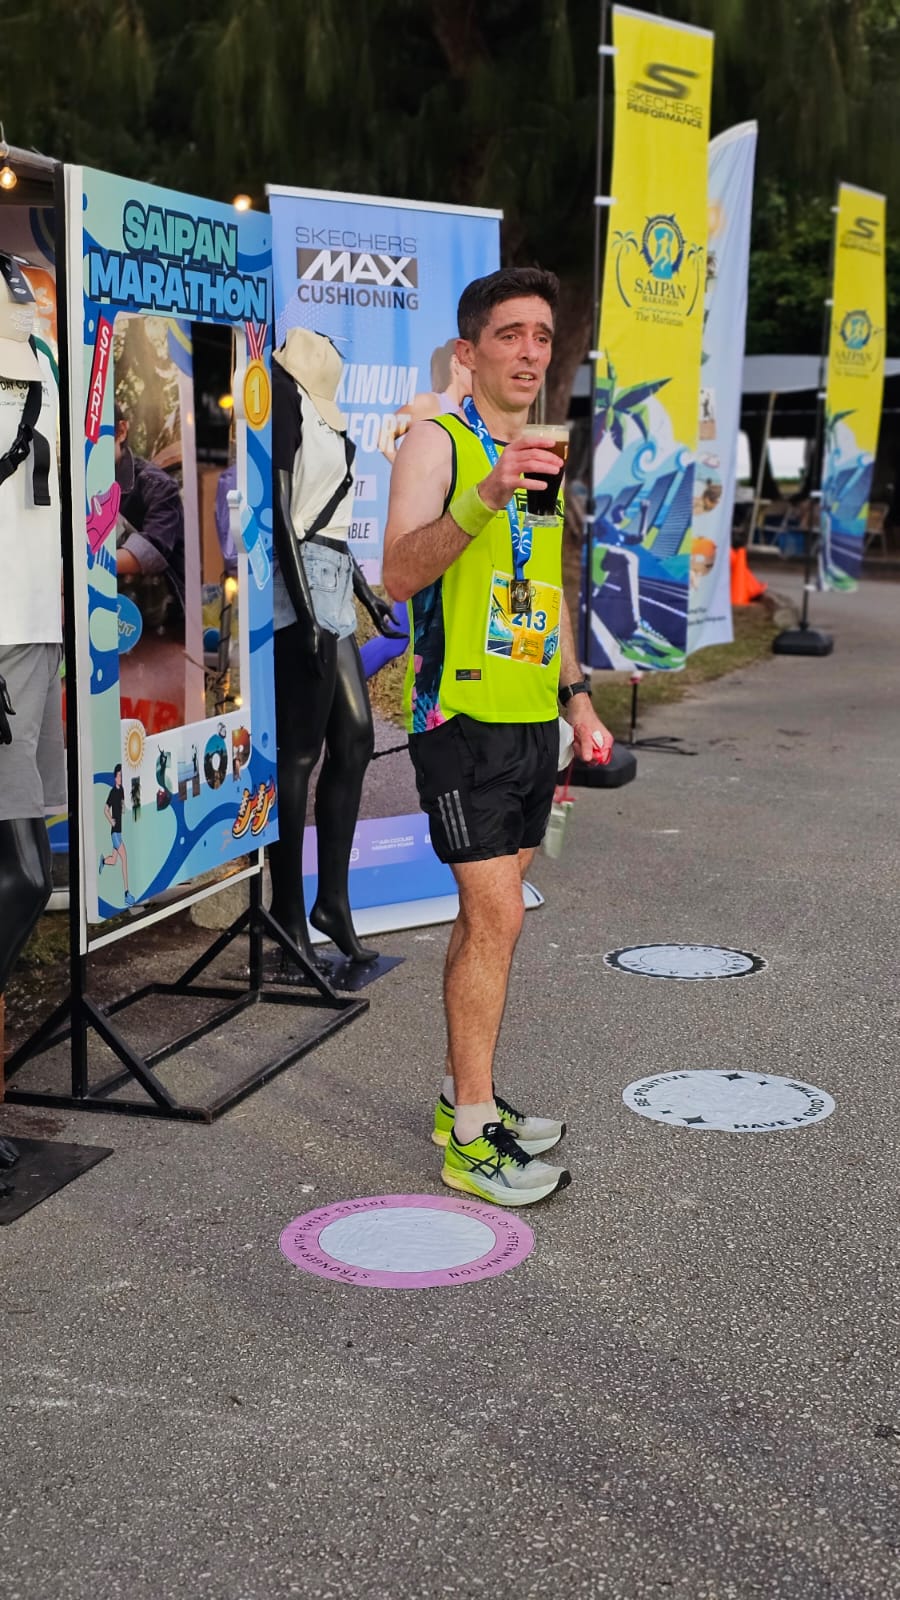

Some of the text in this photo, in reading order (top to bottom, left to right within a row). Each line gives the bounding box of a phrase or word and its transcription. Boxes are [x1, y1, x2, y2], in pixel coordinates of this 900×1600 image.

[626, 88, 704, 119] SKECHERS
[626, 102, 703, 129] PERFORMANCE
[123, 201, 238, 272] SAIPAN
[296, 226, 418, 254] SKECHERS
[89, 250, 268, 322] MARATHON
[300, 248, 415, 289] MAX
[297, 284, 420, 310] CUSHIONING
[634, 277, 687, 300] SAIPAN
[90, 325, 110, 437] START
[251, 369, 261, 415] 1
[334, 363, 418, 406] XIMUM
[345, 412, 412, 453] FORT
[511, 610, 547, 632] 213
[155, 726, 251, 811] SHOP
[633, 1073, 691, 1108] BE POSITIVE
[784, 1082, 820, 1099] TIME
[802, 1098, 826, 1118] GOOD
[733, 1119, 792, 1130] HAVE
[293, 1199, 387, 1279] STRONGER WITH EVERY STRIDE
[448, 1205, 520, 1279] MILES OF DETERMINATION
